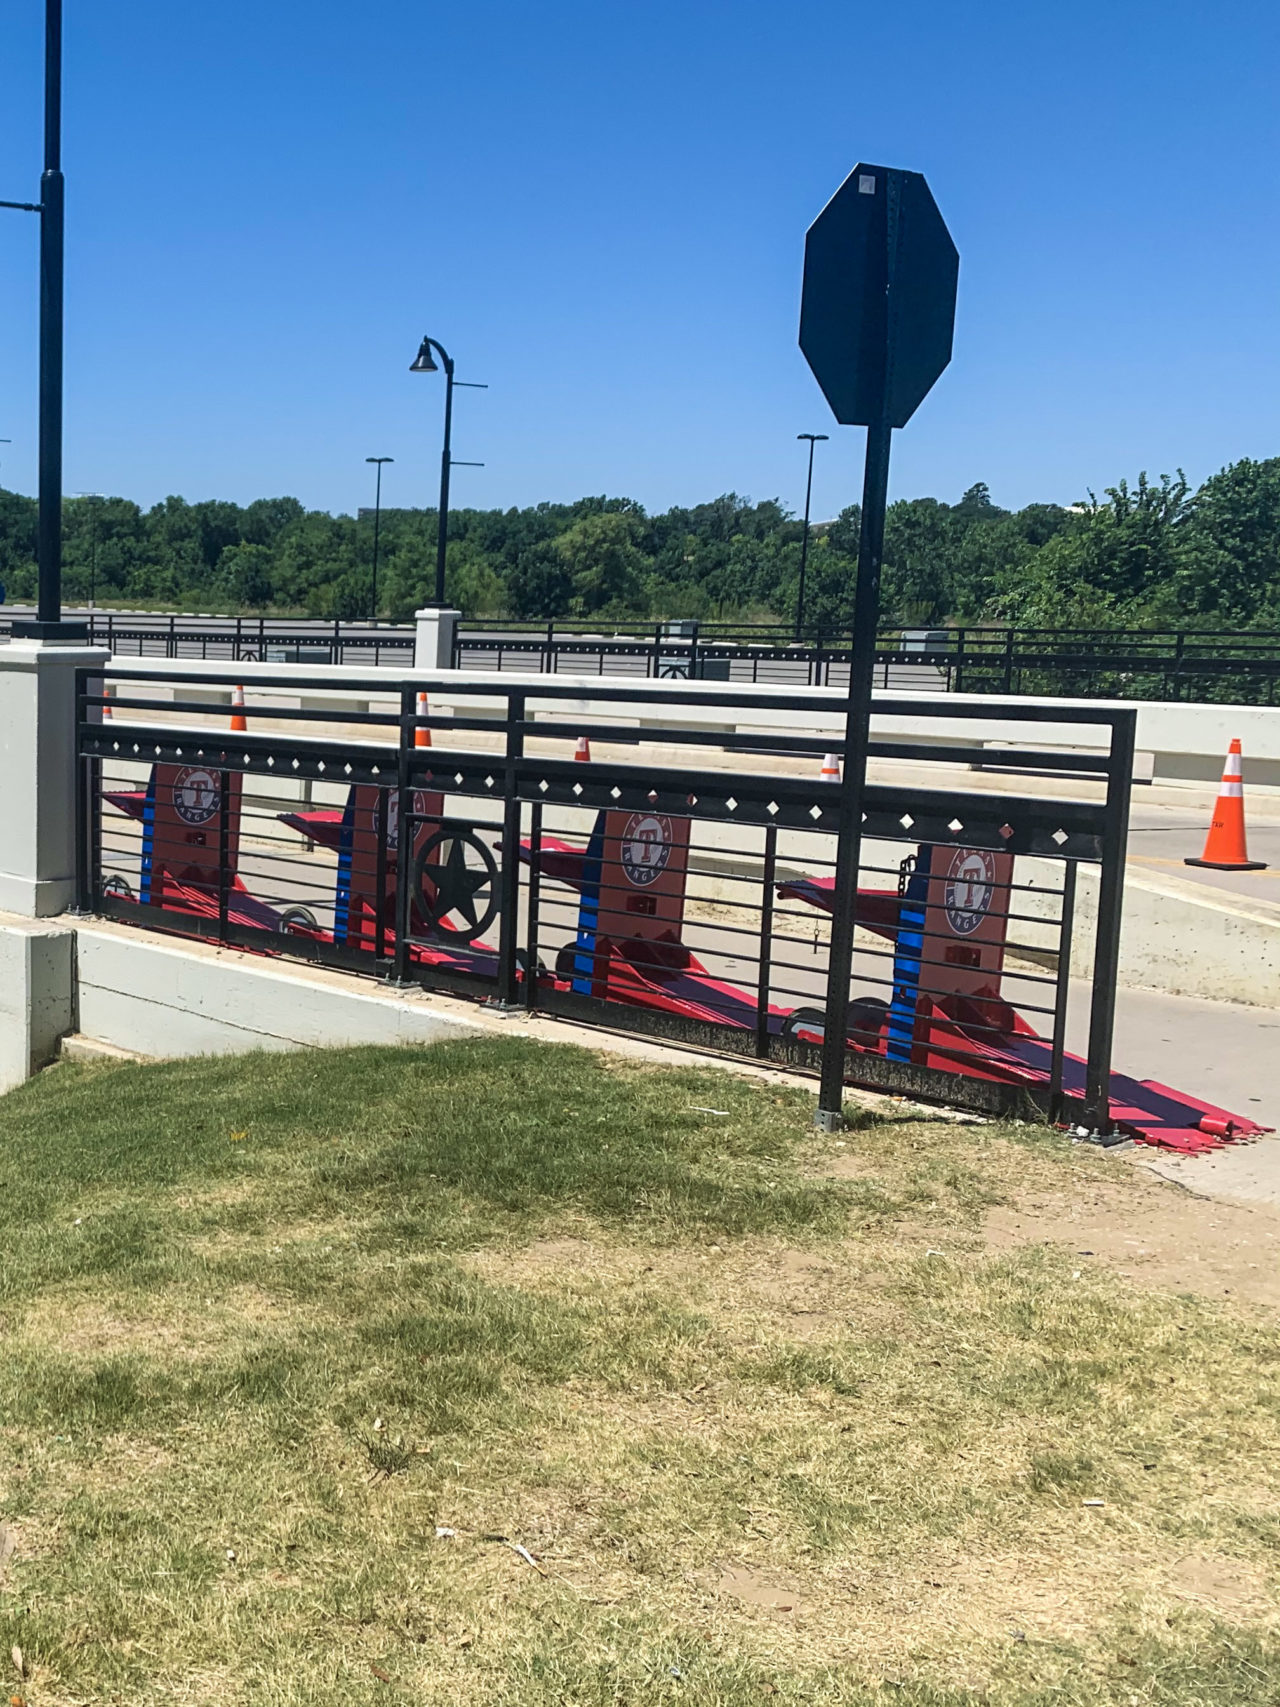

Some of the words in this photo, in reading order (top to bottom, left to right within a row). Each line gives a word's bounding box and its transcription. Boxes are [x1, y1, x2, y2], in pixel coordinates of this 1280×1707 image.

[189, 780, 209, 806] T
[638, 829, 658, 863] T
[962, 868, 982, 907] T
